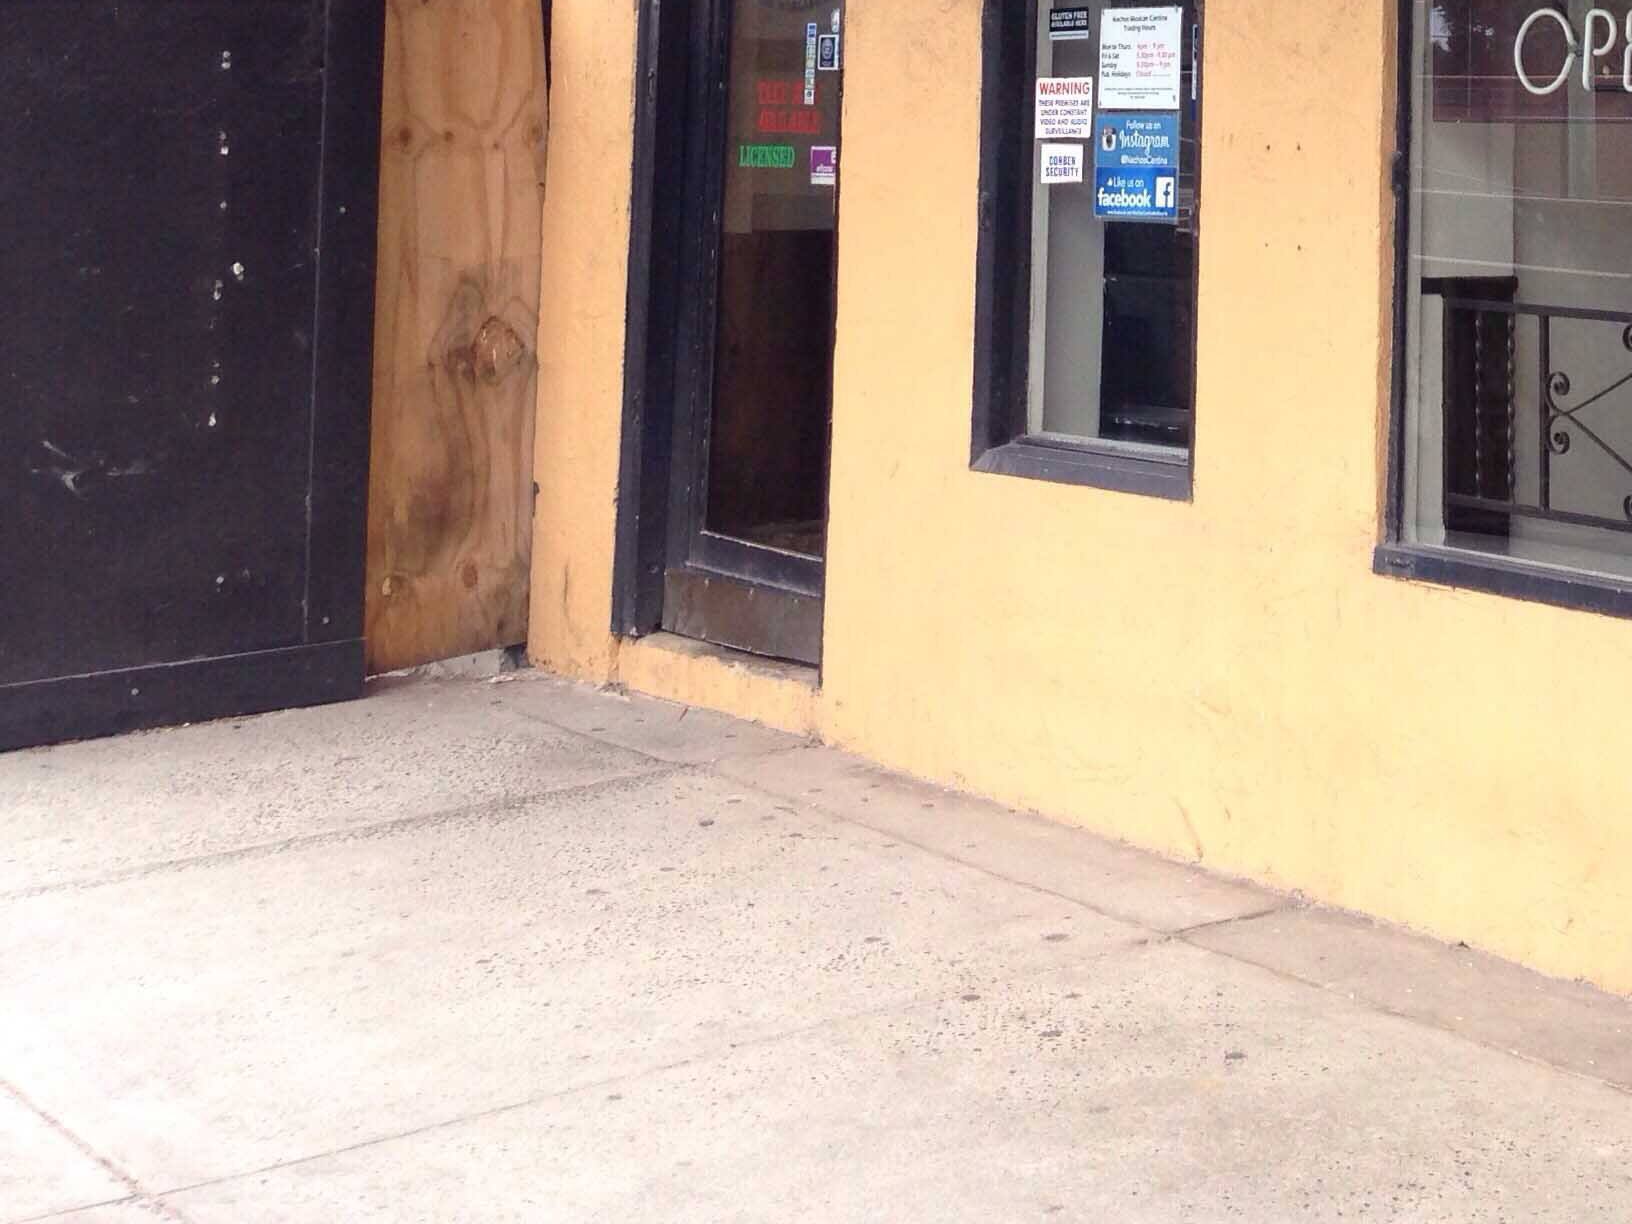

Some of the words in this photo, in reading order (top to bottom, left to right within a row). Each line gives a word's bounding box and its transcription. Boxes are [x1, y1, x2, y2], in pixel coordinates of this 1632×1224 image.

[1039, 82, 1090, 95] WARNING
[1126, 120, 1144, 129] Follow
[1045, 127, 1081, 135] SURVEILLANCE
[1119, 129, 1170, 156] Instagram
[738, 145, 796, 168] LICENSED
[1045, 167, 1079, 177] SECURITY
[1113, 176, 1126, 188] Like
[1127, 180, 1134, 188] us
[1135, 179, 1145, 188] on
[1097, 187, 1152, 208] facebook
